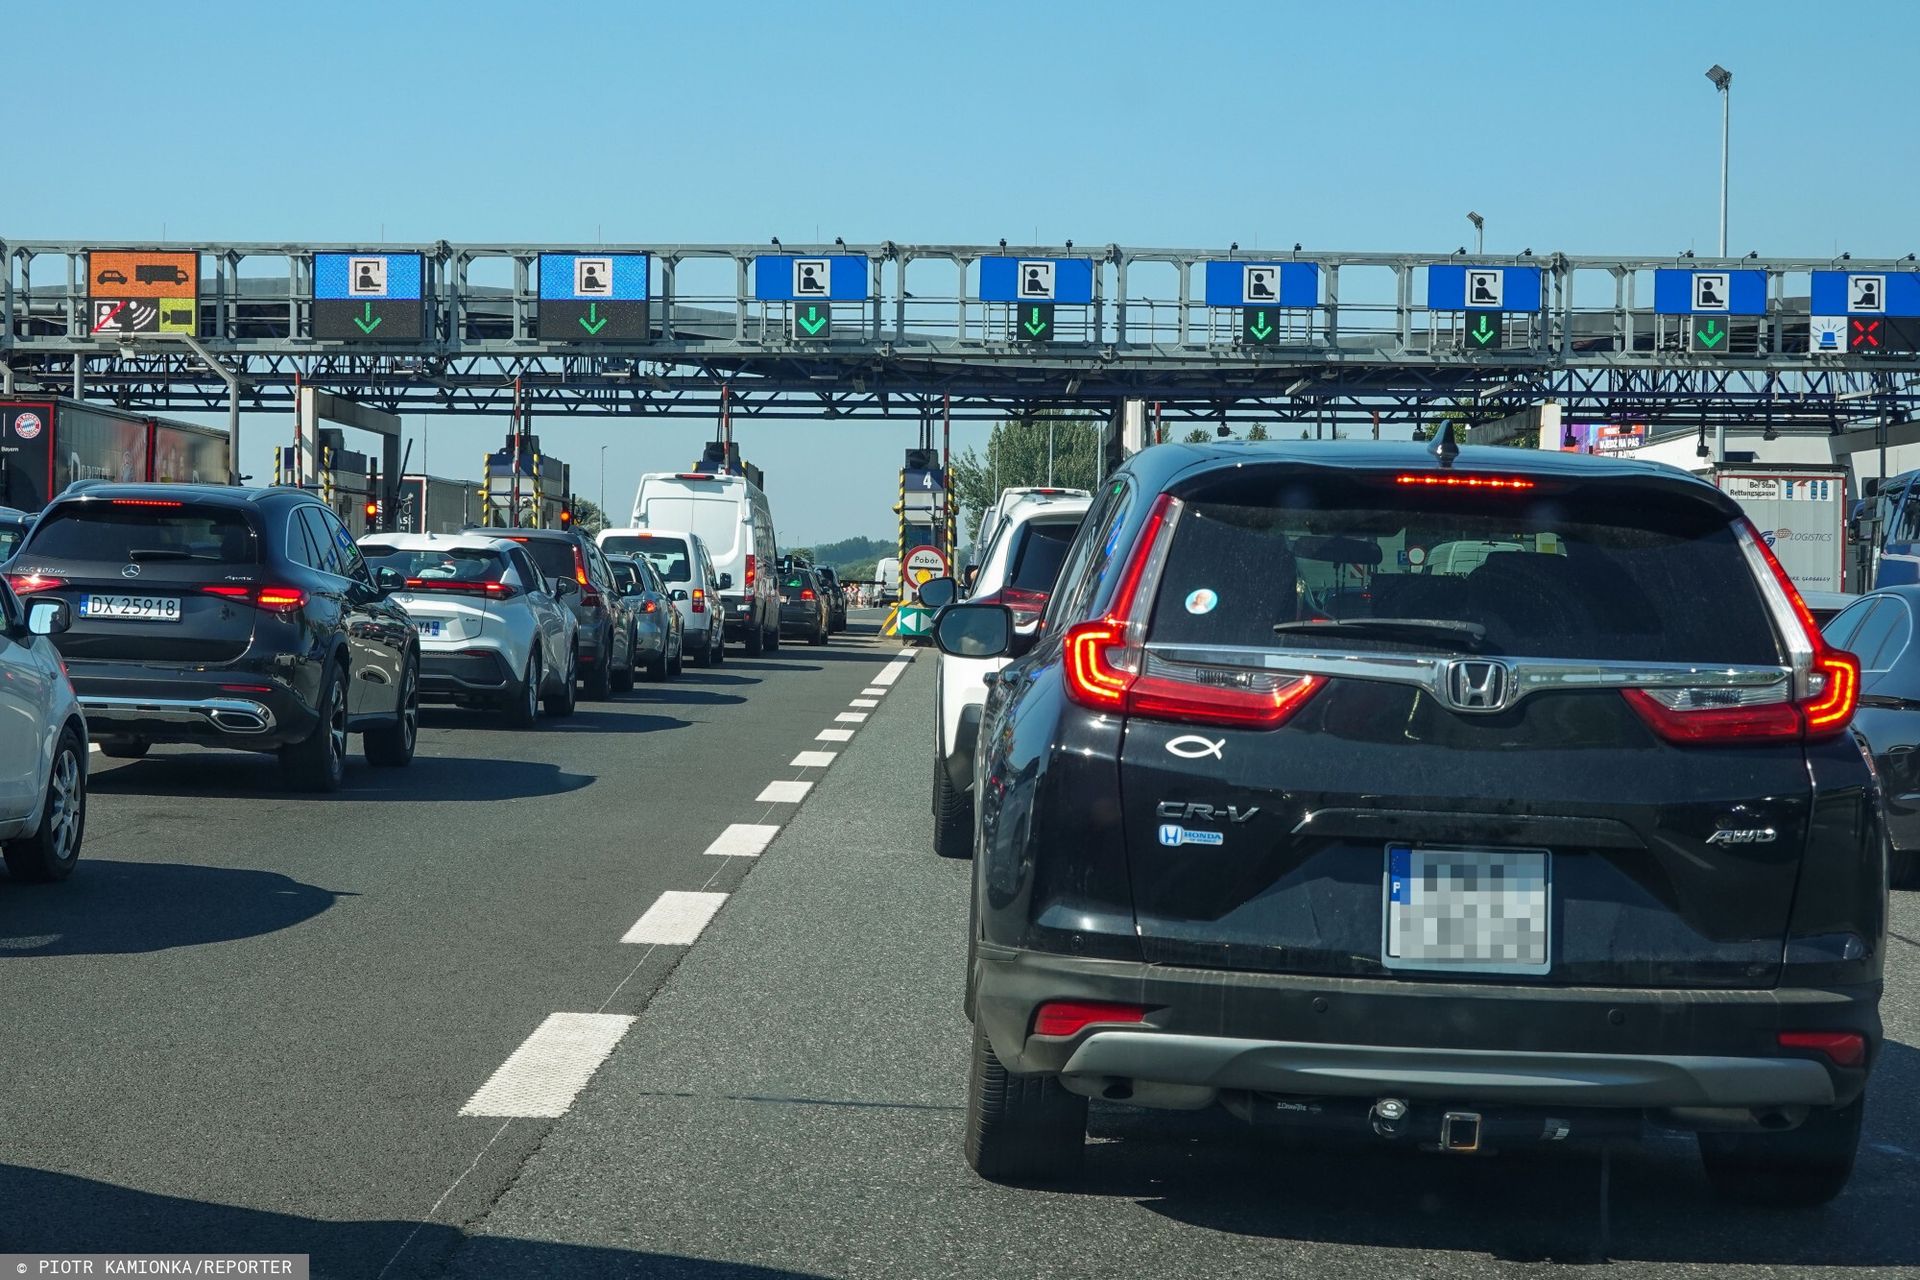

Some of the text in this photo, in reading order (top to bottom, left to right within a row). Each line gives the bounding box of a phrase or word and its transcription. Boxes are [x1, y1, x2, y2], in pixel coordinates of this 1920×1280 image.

[923, 472, 932, 489] 4
[1790, 533, 1832, 542] LOGISTICS
[91, 597, 114, 614] DX
[121, 598, 176, 617] 25918
[1156, 801, 1260, 822] CR-V
[1184, 831, 1222, 840] HONDA
[1705, 830, 1777, 844] AWD
